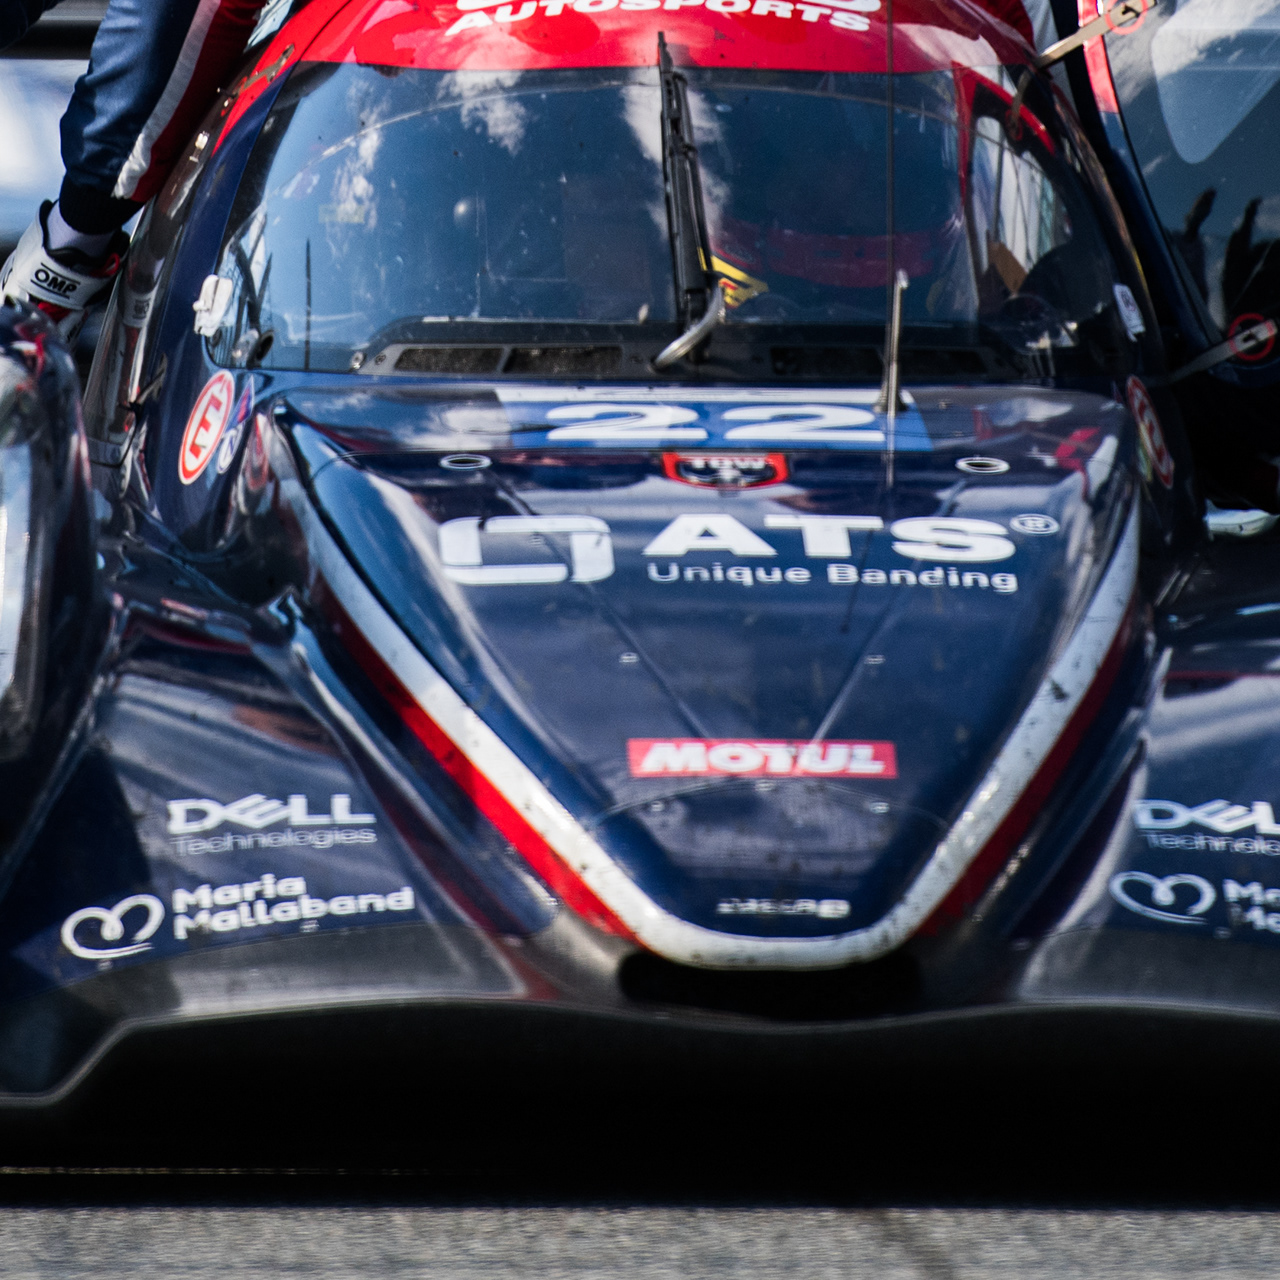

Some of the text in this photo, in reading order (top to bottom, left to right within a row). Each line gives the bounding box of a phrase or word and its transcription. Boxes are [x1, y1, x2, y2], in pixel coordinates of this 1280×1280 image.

[34, 268, 78, 294] OMP
[545, 403, 887, 442] 22
[647, 561, 1018, 594] Unique Banding
[640, 742, 885, 774] MOTUL
[166, 793, 377, 834] DELL
[169, 827, 378, 857] Technologies
[172, 873, 307, 914] Maria
[173, 886, 415, 941] Mallaband
